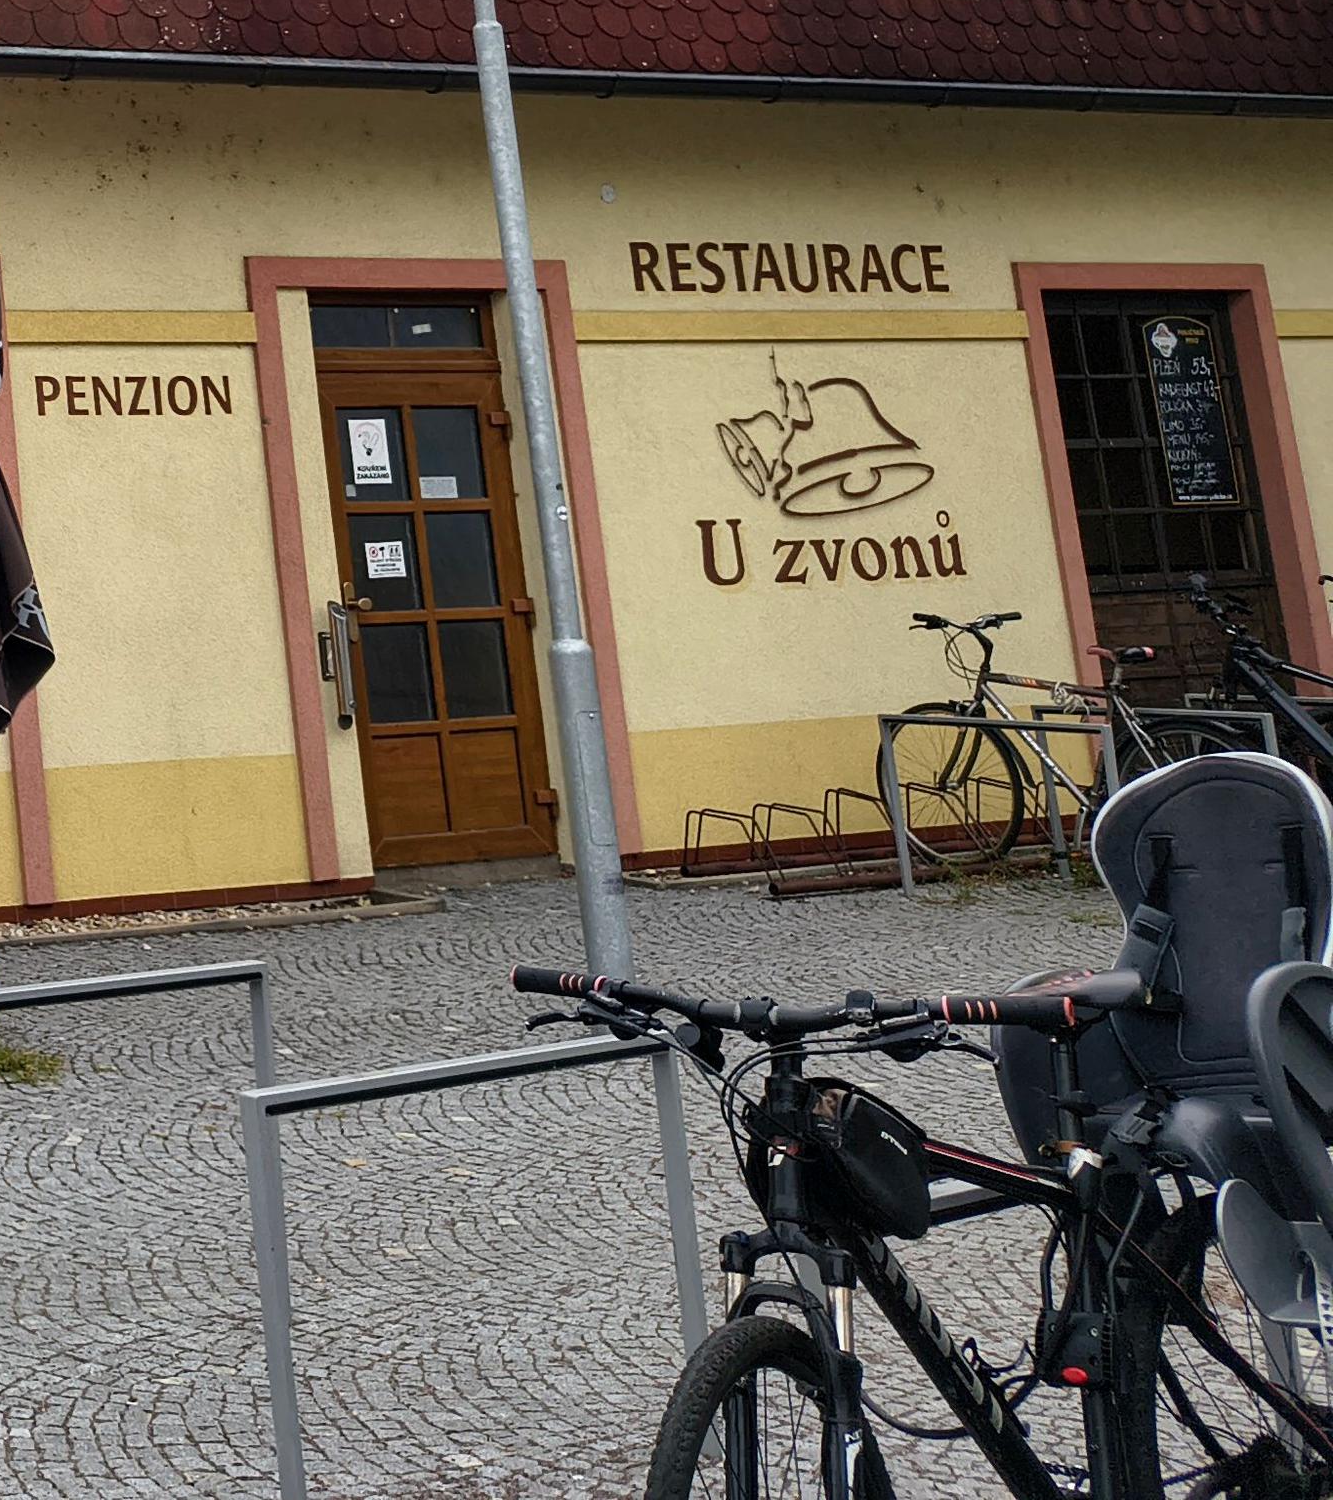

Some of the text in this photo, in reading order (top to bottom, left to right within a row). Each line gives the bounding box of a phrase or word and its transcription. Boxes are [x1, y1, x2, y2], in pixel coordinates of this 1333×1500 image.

[628, 241, 951, 294] RESTAURACE
[34, 375, 233, 417] PENZION
[695, 510, 969, 587] U zvonů
